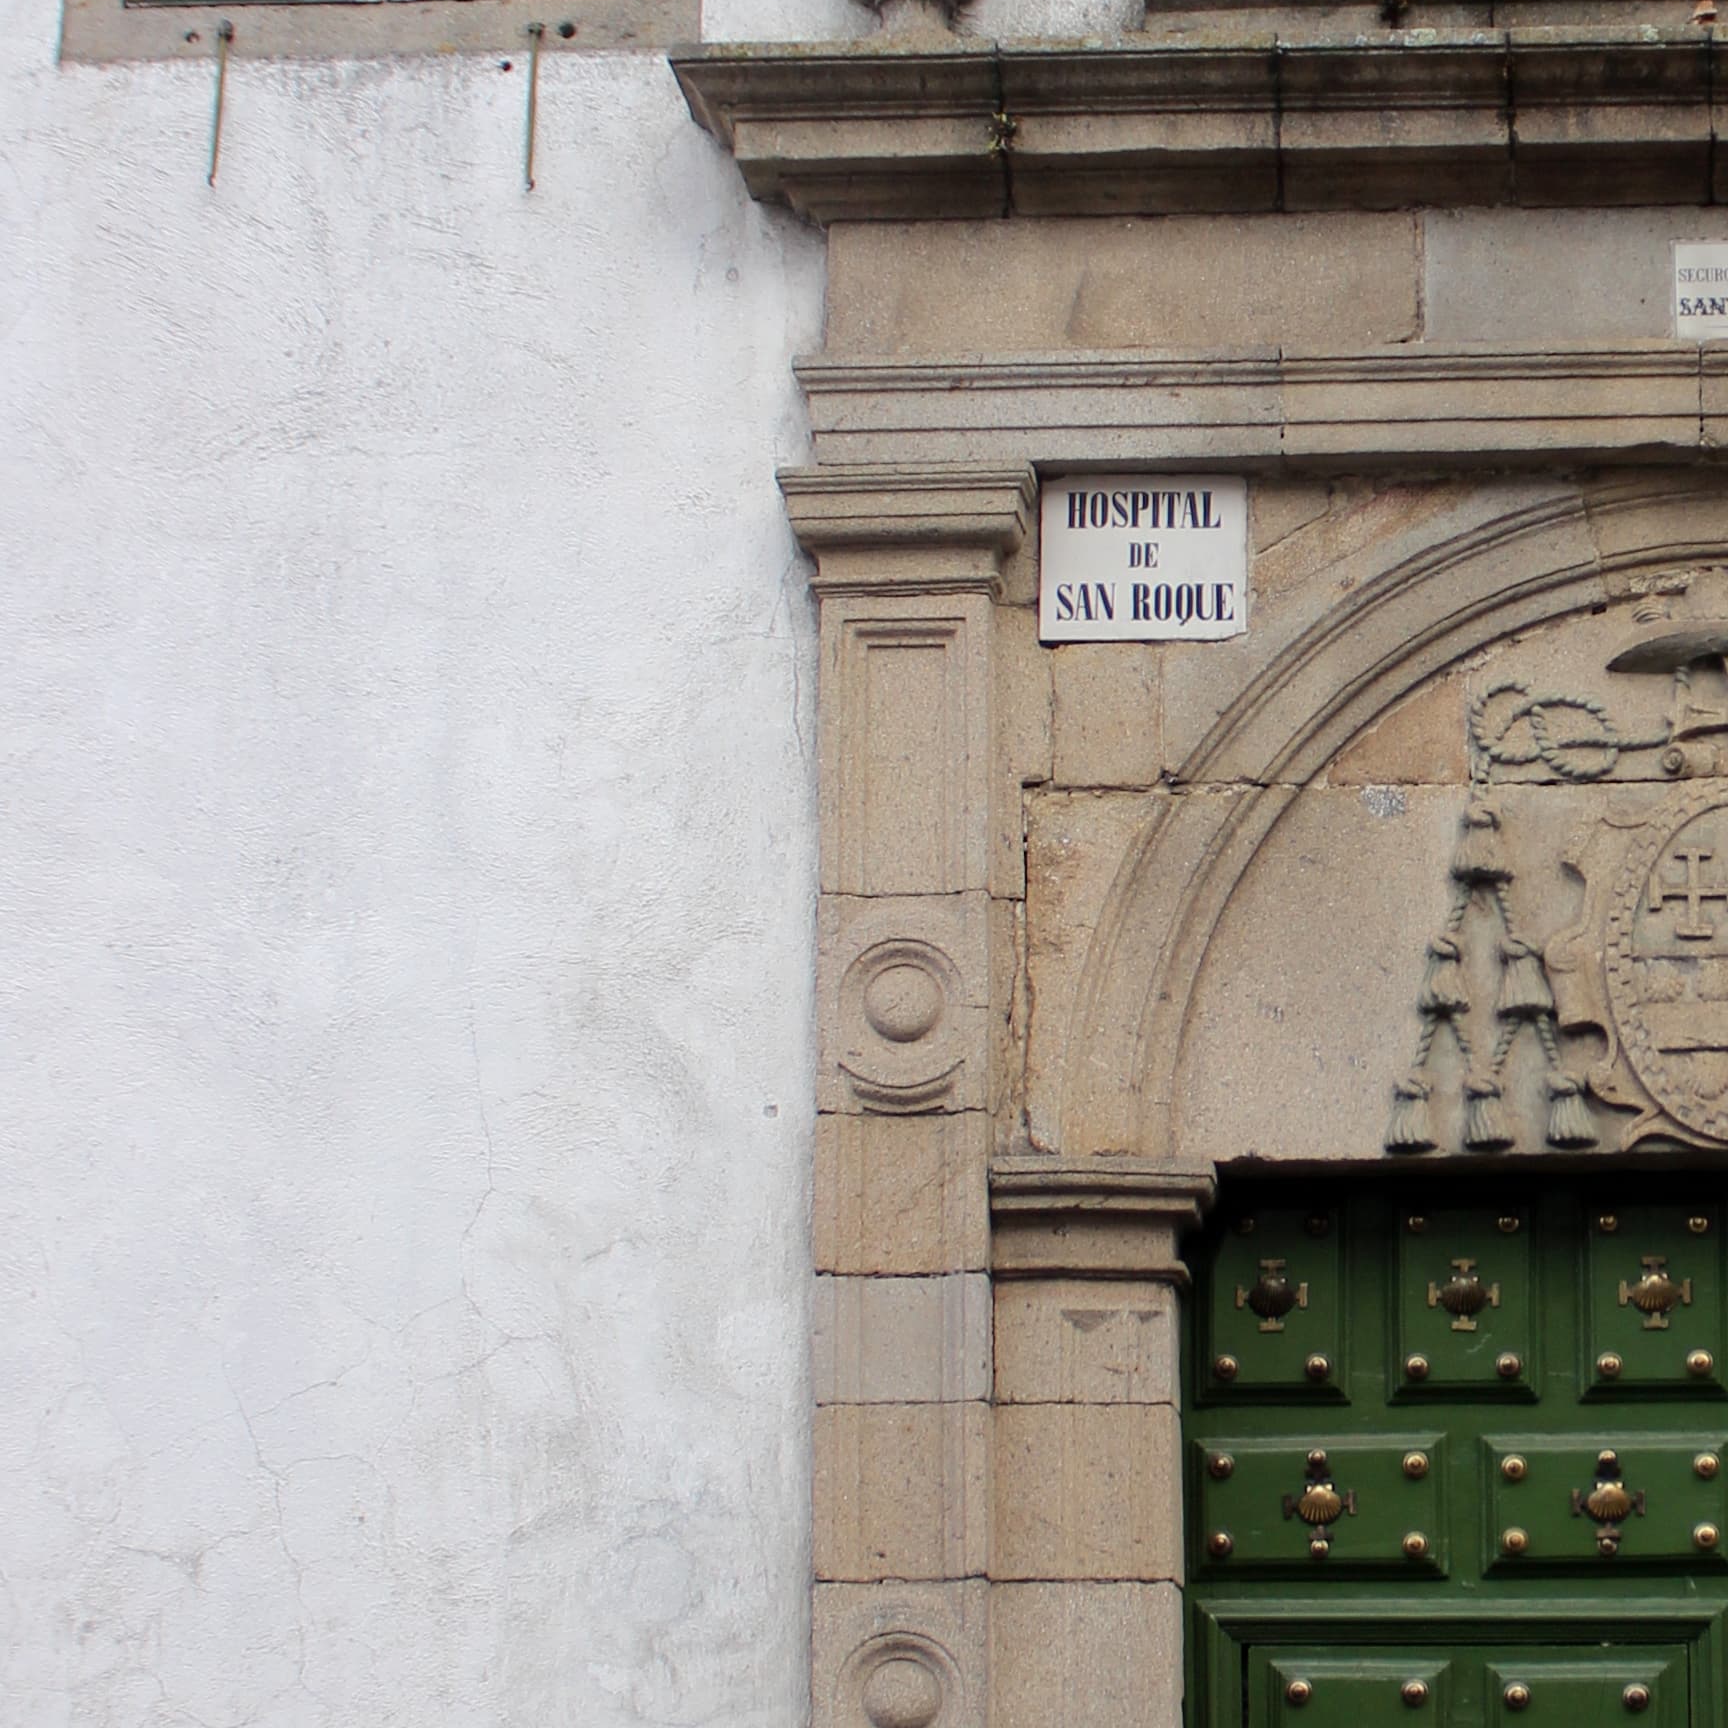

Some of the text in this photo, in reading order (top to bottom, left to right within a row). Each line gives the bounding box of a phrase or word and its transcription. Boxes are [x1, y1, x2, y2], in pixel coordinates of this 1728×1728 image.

[1067, 491, 1221, 529] HOSPITAL
[1128, 542, 1160, 569] DE
[1056, 583, 1235, 627] SAN ROQUE
